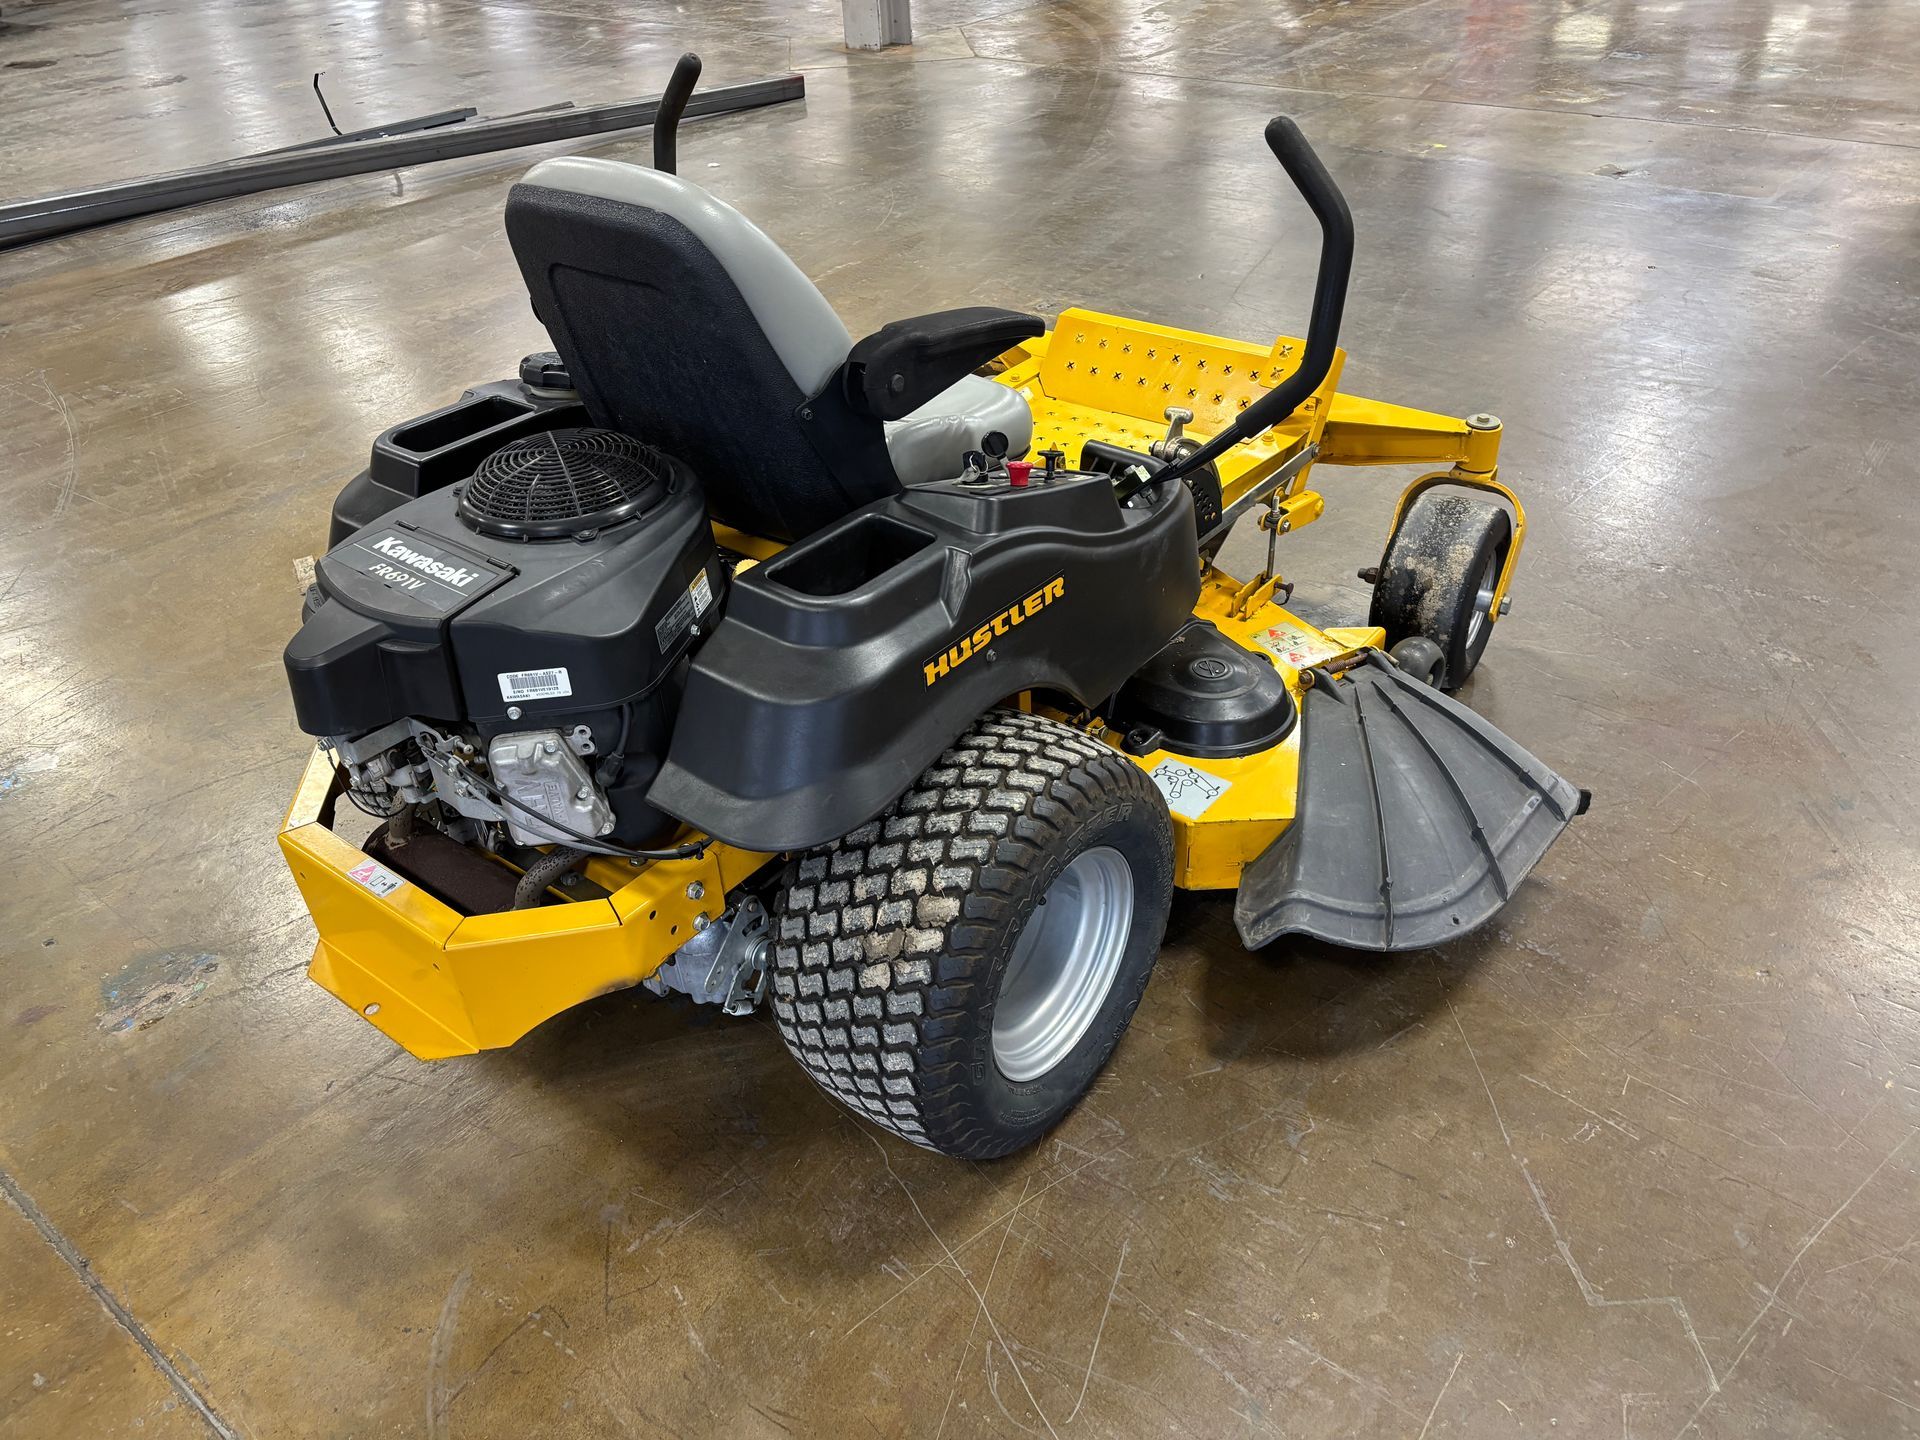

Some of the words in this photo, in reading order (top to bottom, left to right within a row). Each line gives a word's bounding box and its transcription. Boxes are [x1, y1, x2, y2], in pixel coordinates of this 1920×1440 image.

[368, 563, 426, 590] FR691V
[371, 536, 480, 588] Kawasaki
[923, 576, 1065, 687] HUSTLER
